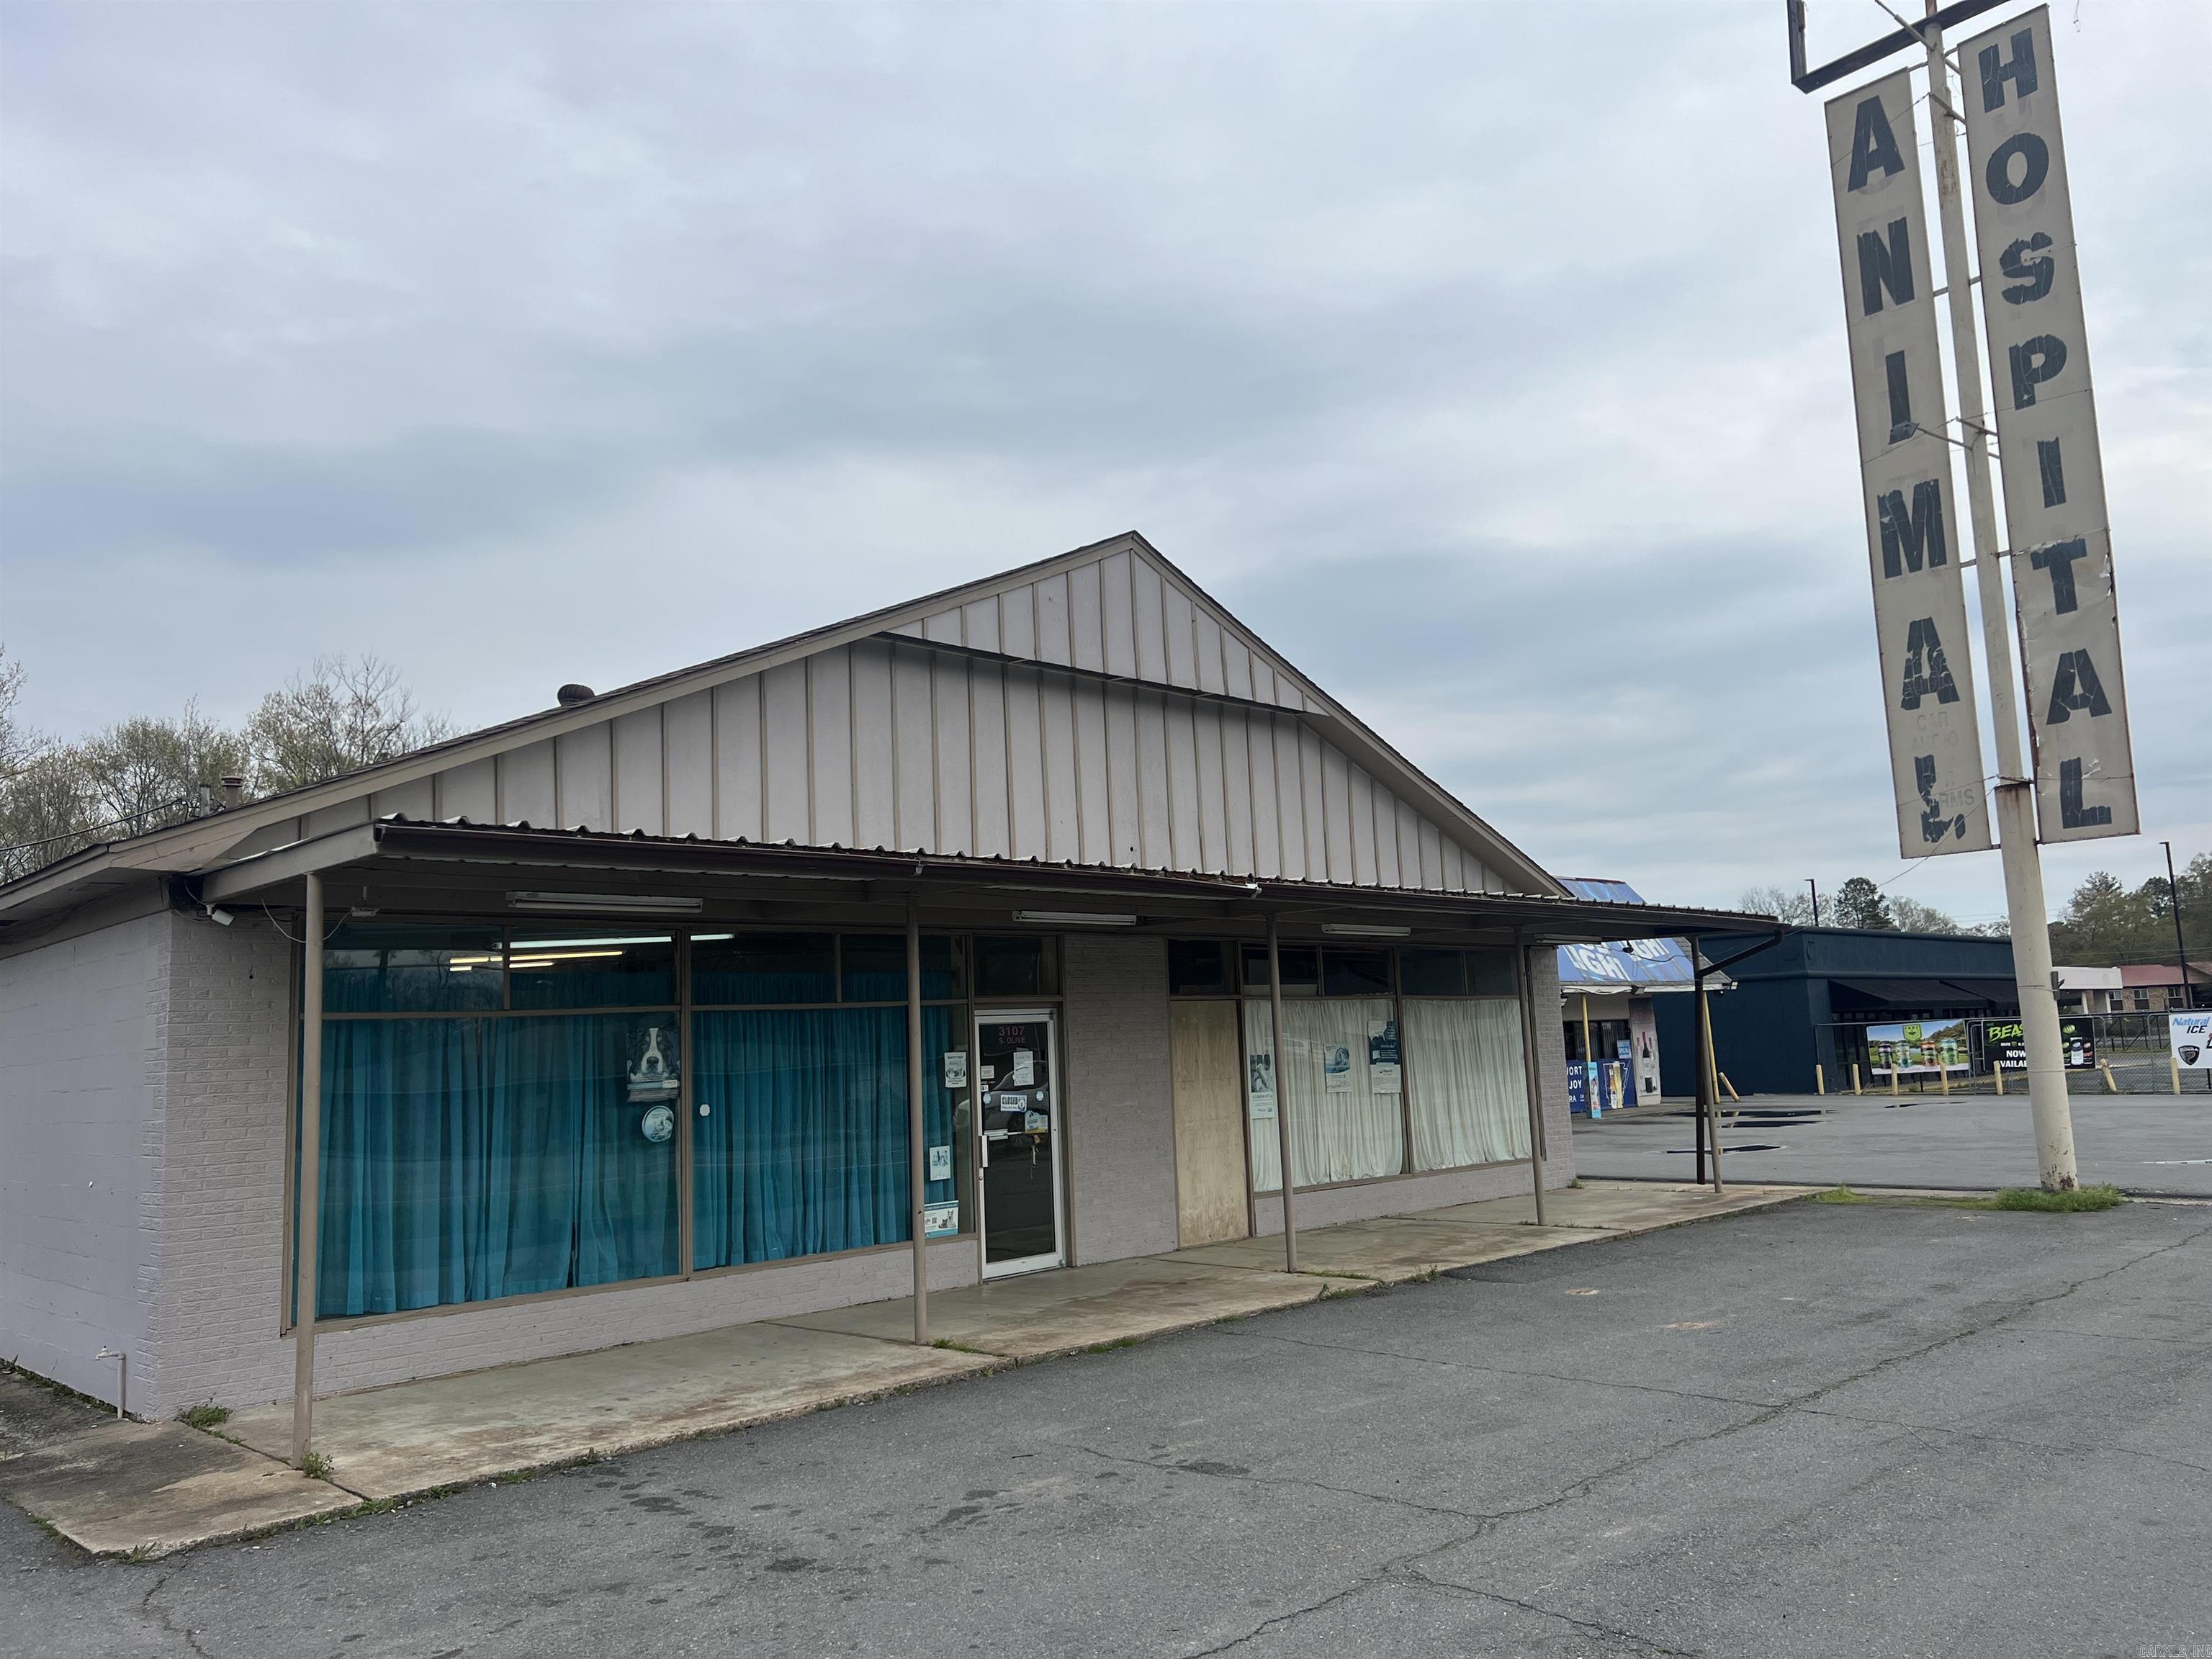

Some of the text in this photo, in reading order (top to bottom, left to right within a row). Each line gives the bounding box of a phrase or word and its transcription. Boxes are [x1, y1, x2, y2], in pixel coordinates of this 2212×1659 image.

[1978, 27, 2113, 830] HOSPITAL
[1848, 94, 1966, 844] ANIMAL
[2172, 1017, 2211, 1026] Natural
[998, 1026, 1025, 1036] 3107
[1569, 1079, 1582, 1089] JOY
[1002, 1096, 1018, 1105] CLOSED
